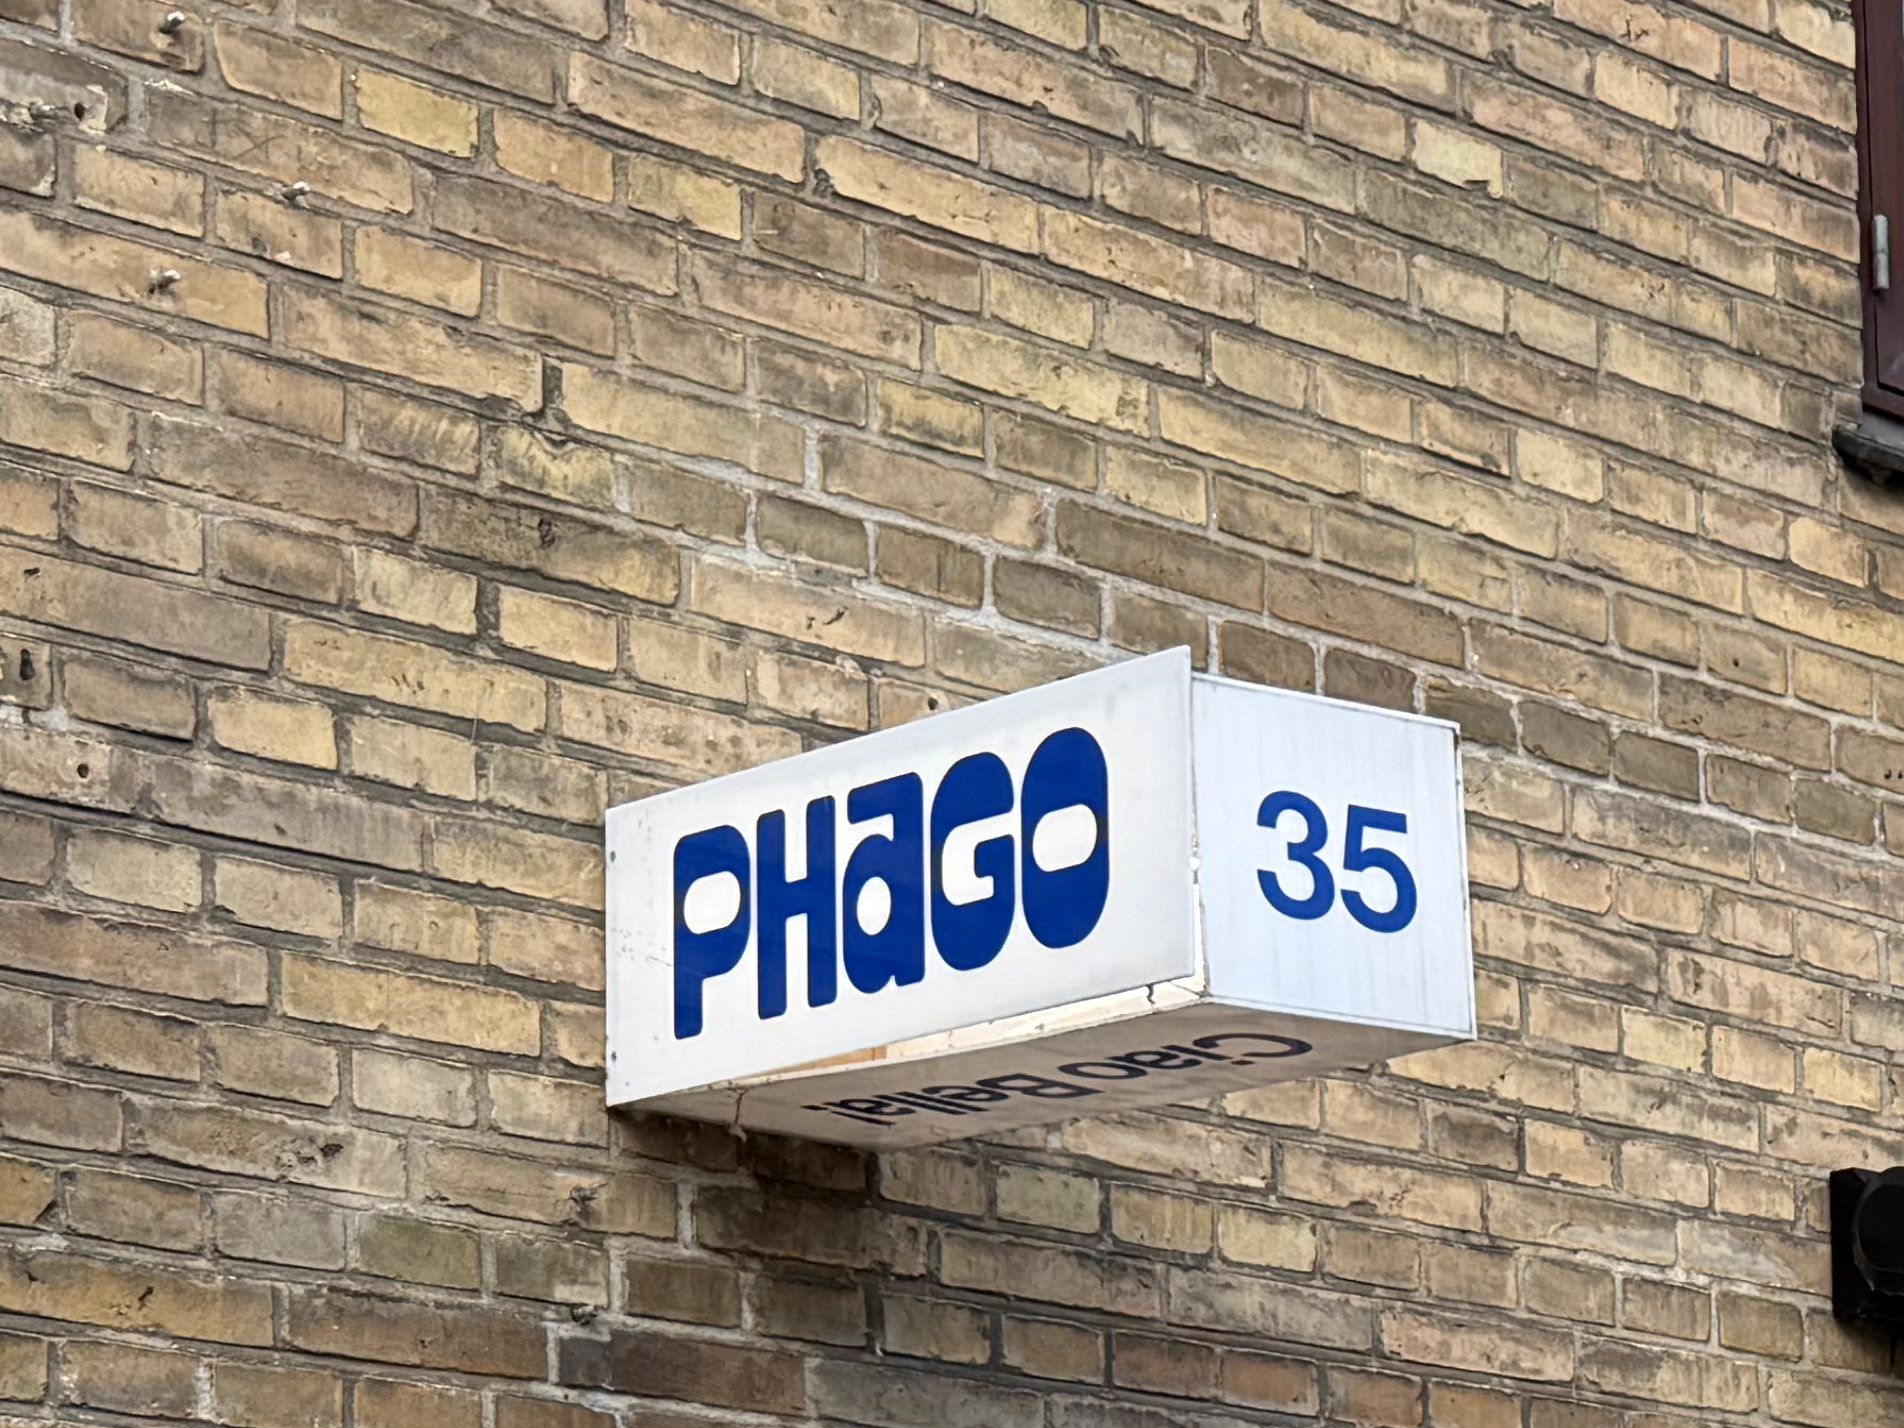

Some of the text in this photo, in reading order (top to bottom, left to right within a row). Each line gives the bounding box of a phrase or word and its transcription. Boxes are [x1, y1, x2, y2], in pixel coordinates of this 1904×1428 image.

[1257, 790, 1418, 935] 35
[801, 1033, 1313, 1127] Ciao Bella!
